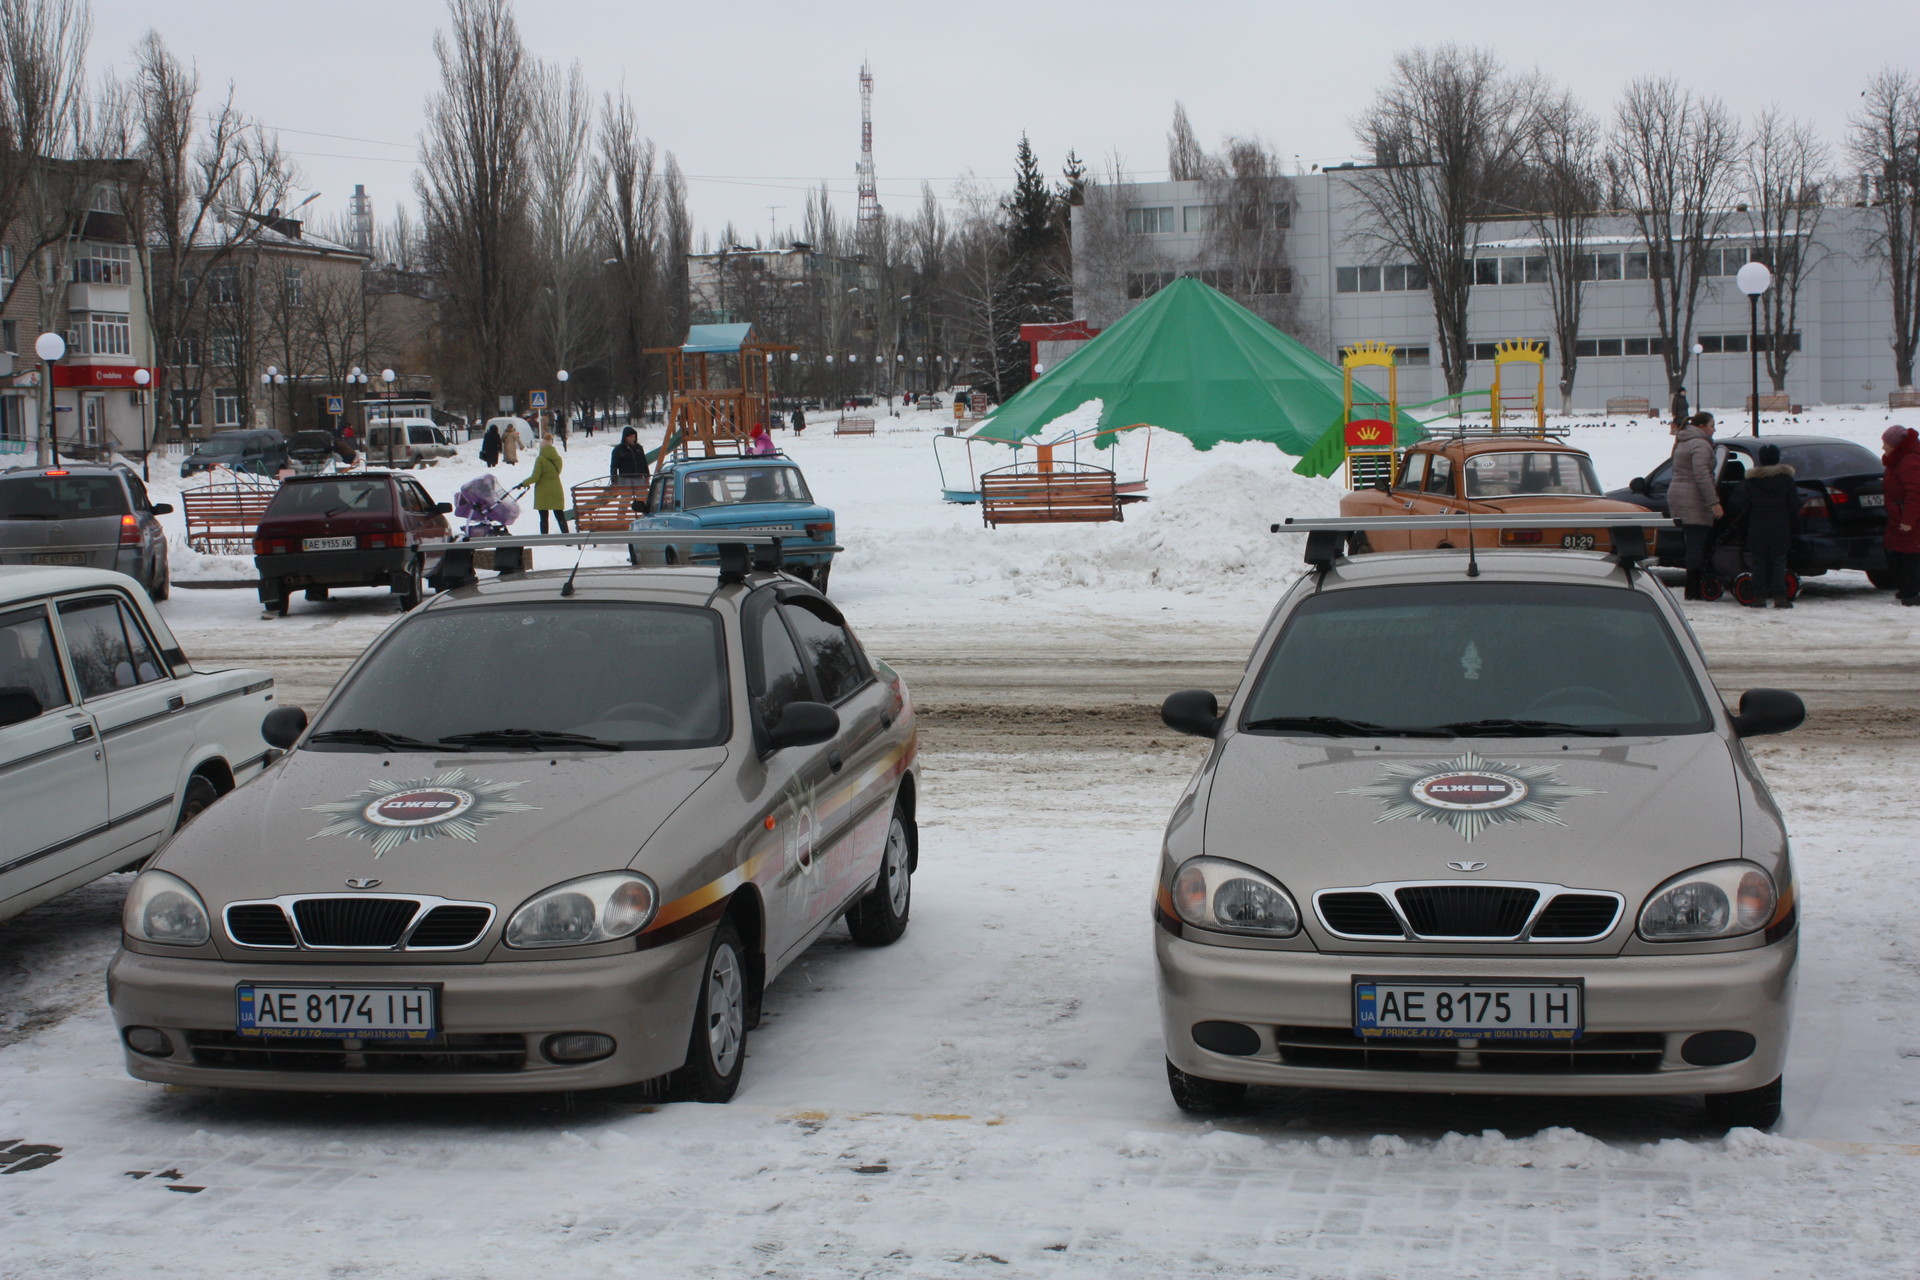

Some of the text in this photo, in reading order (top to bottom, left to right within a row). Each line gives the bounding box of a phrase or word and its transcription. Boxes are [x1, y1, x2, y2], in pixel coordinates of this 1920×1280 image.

[308, 539, 353, 550] AE 9155 AK
[258, 993, 424, 1025] AE 8174 IH
[1379, 991, 1569, 1024] AE 8175 IH
[241, 1012, 254, 1022] UA
[1360, 1011, 1375, 1022] UA
